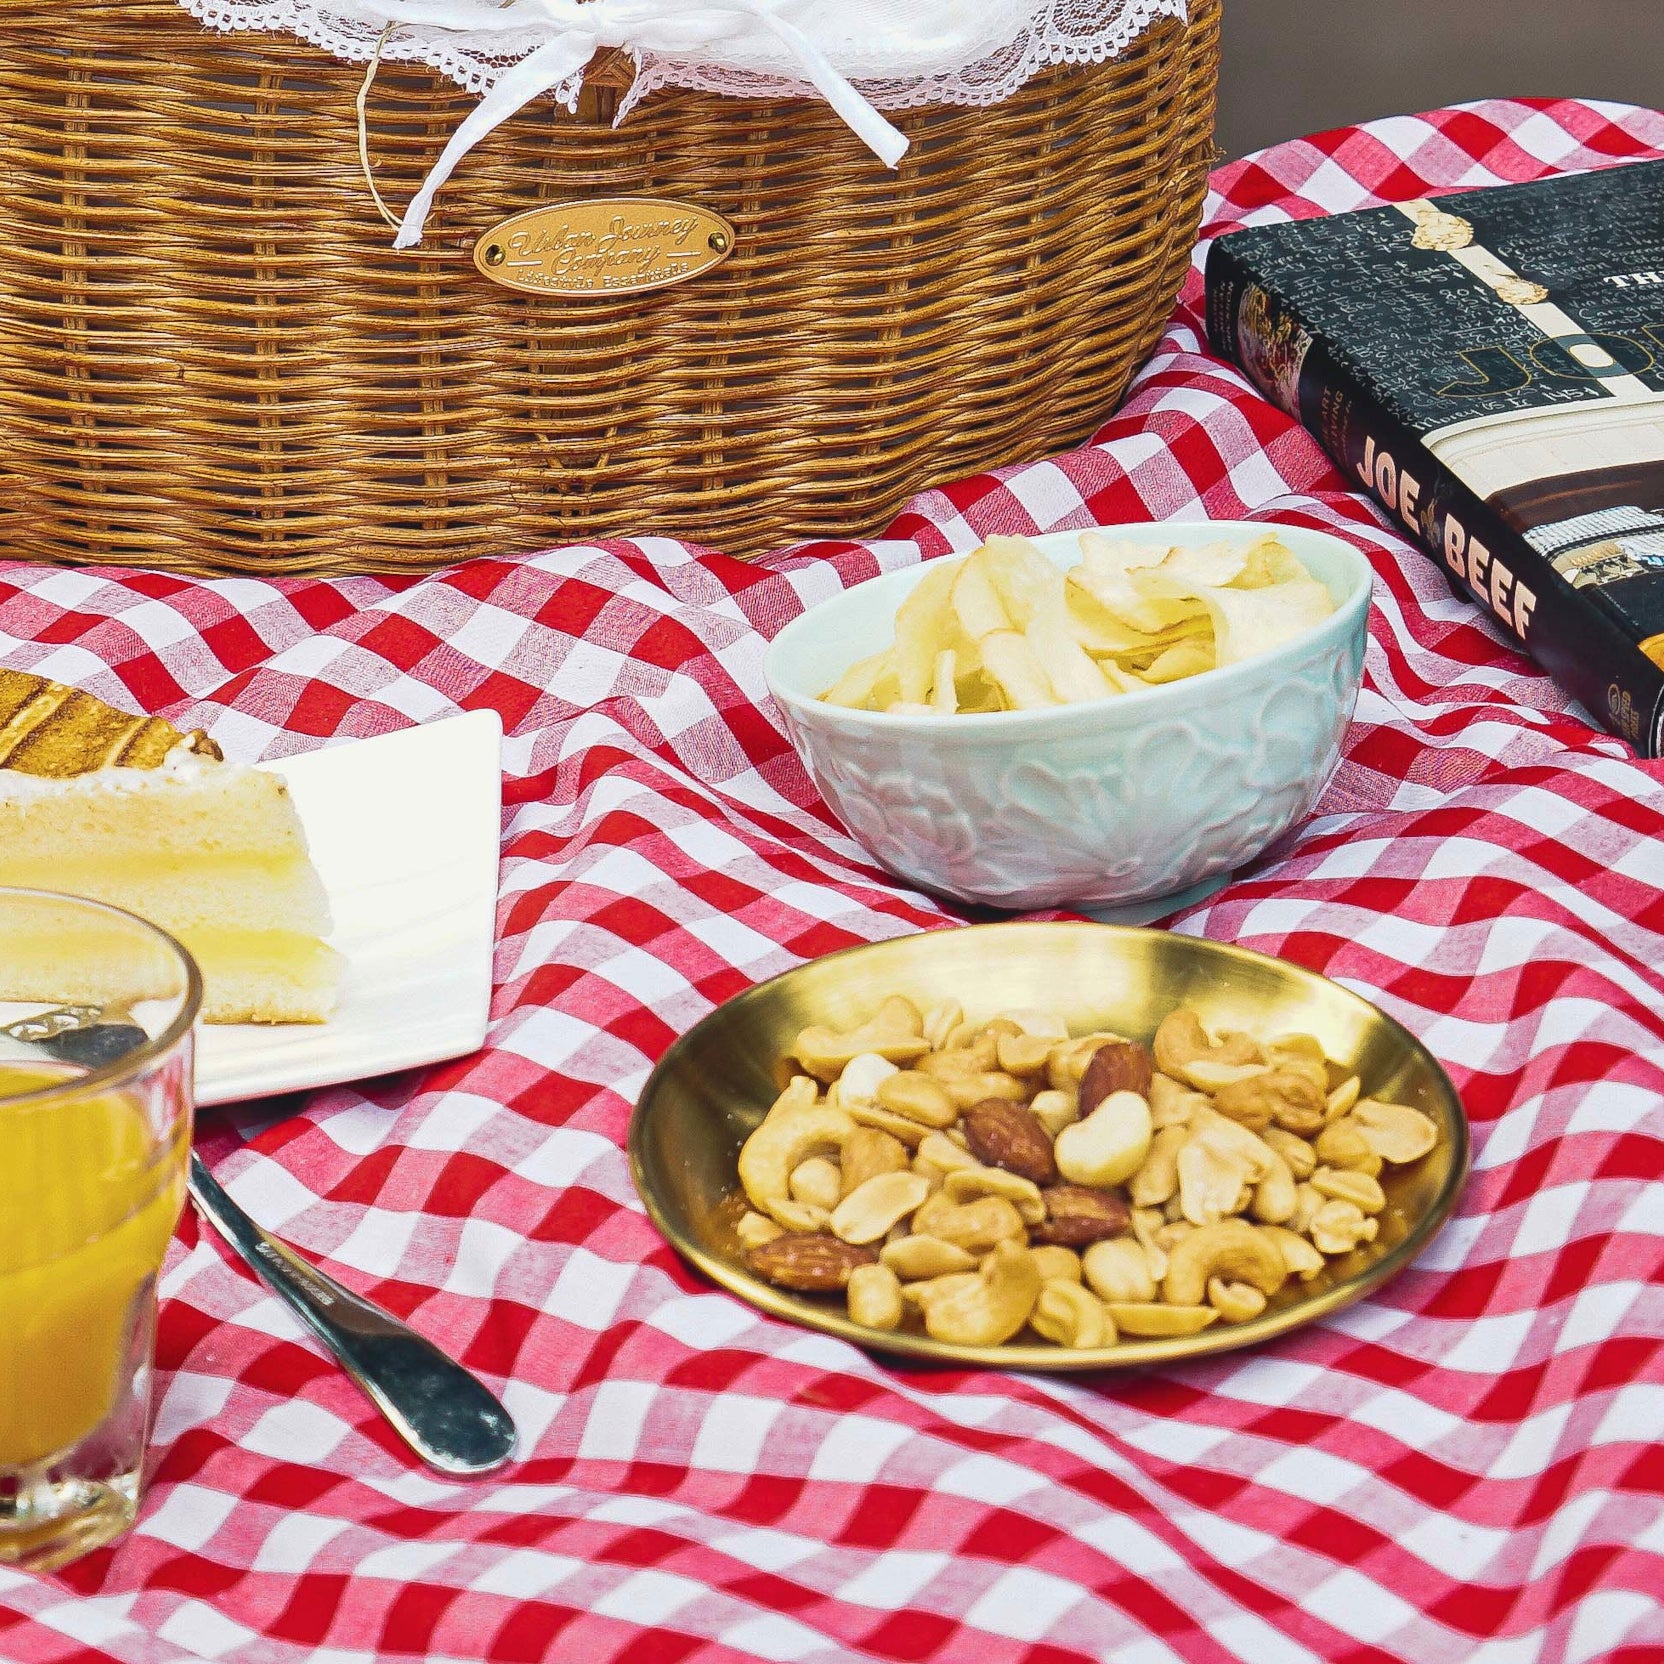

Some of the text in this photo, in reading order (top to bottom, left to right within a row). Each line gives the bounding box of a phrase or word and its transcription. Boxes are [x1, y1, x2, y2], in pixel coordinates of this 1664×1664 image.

[597, 215, 699, 253] Journey
[551, 244, 661, 276] Company
[1355, 435, 1421, 537] JOE
[1443, 512, 1538, 641] BEEF
